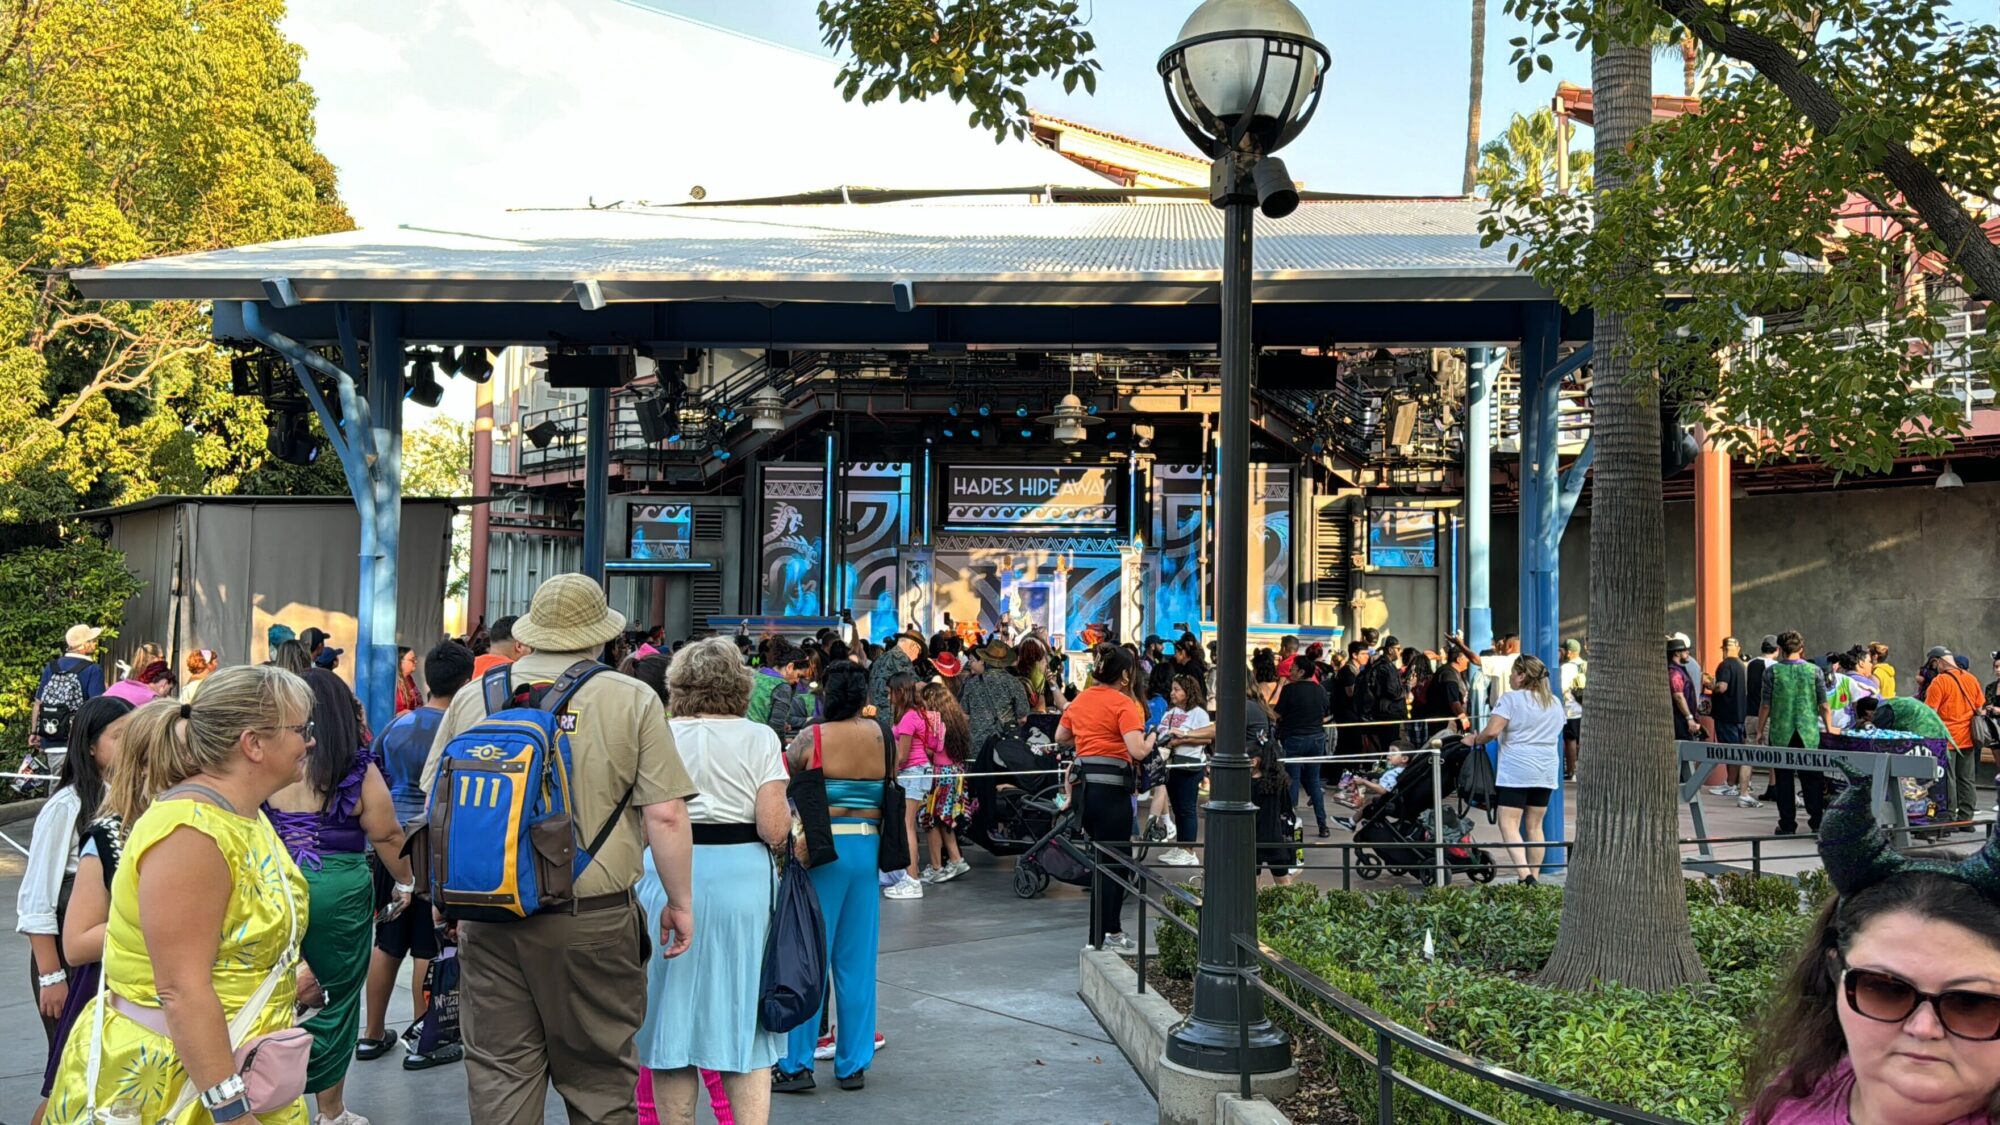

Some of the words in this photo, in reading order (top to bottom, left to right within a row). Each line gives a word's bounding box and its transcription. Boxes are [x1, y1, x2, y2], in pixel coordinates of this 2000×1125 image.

[953, 477, 1014, 496] HADES
[1019, 477, 1112, 497] HIDEAWAY
[1706, 746, 1782, 764] HOLLYWOOD
[459, 775, 501, 808] 111
